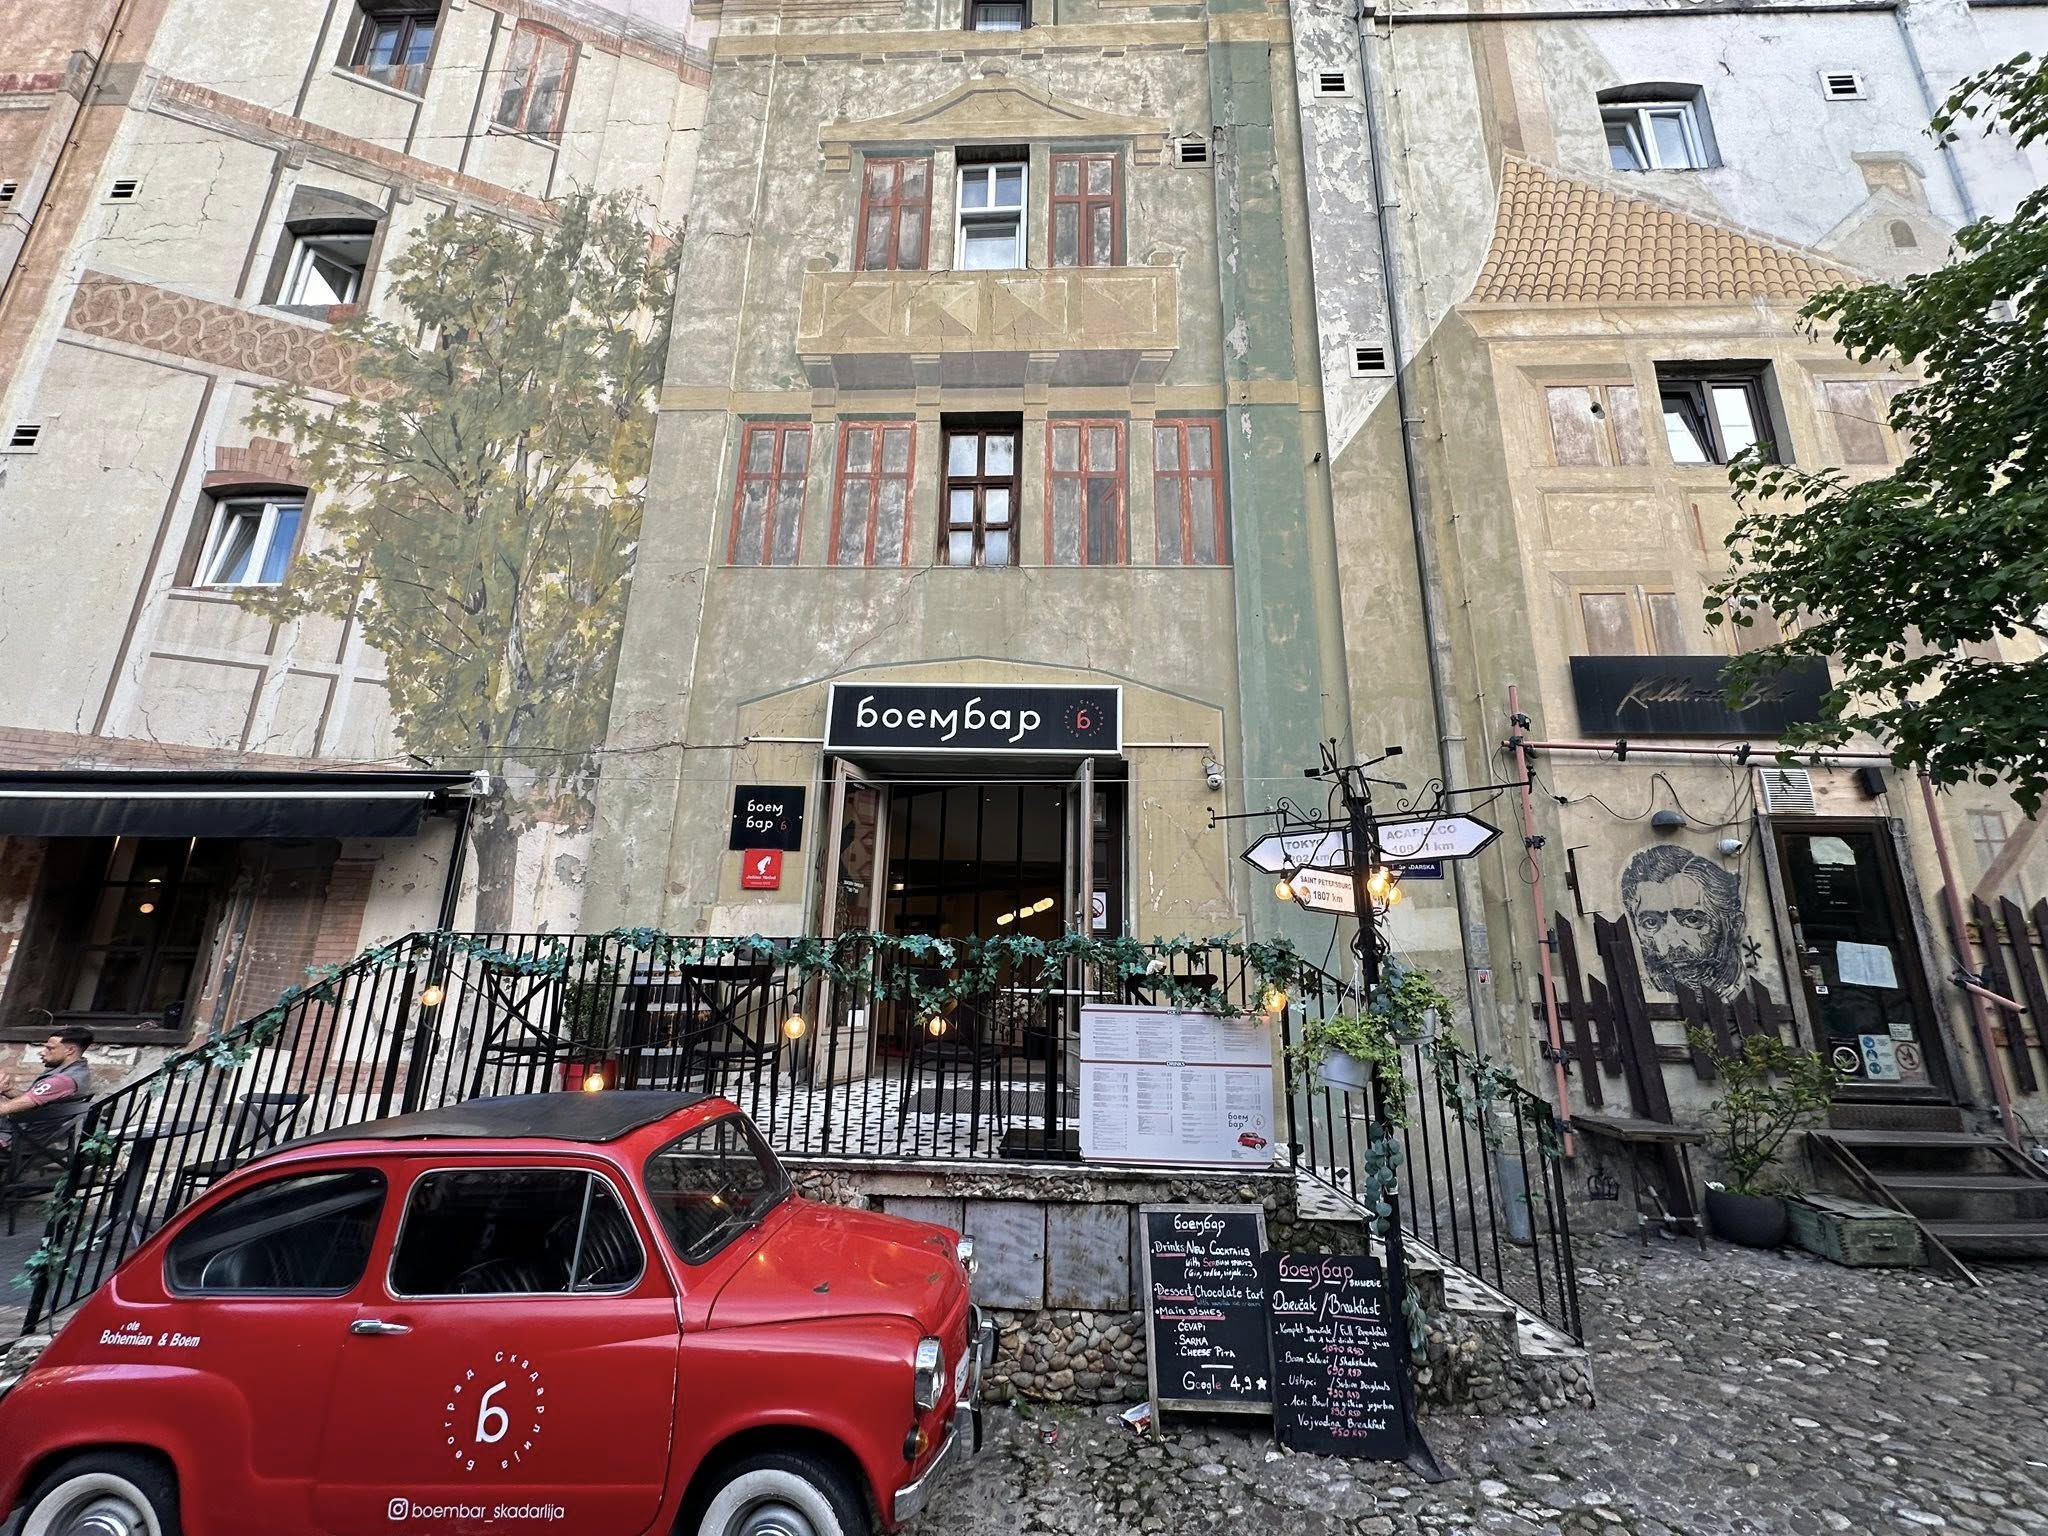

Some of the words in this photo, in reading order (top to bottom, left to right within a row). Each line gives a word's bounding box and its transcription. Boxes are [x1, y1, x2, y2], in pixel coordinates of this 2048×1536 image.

[857, 695, 1041, 744] боембар
[747, 799, 784, 817] боем
[746, 815, 774, 833] бар
[1285, 838, 1325, 850] TOKYO
[1434, 842, 1455, 851] km
[1300, 875, 1317, 885] SAINT
[1318, 878, 1352, 890] PETERSBURG
[1313, 890, 1330, 901] 1807
[1332, 893, 1343, 903] km
[1194, 1284, 1243, 1299] Chocolate
[1245, 1286, 1265, 1300] tart
[1159, 1306, 1186, 1315] Main
[100, 1330, 153, 1346] Bohemian
[157, 1332, 169, 1346] &
[169, 1333, 201, 1347] Boem
[1182, 1370, 1222, 1395] Google
[1230, 1374, 1252, 1394] 4,9
[411, 1502, 565, 1523] boembar_skadarlija
